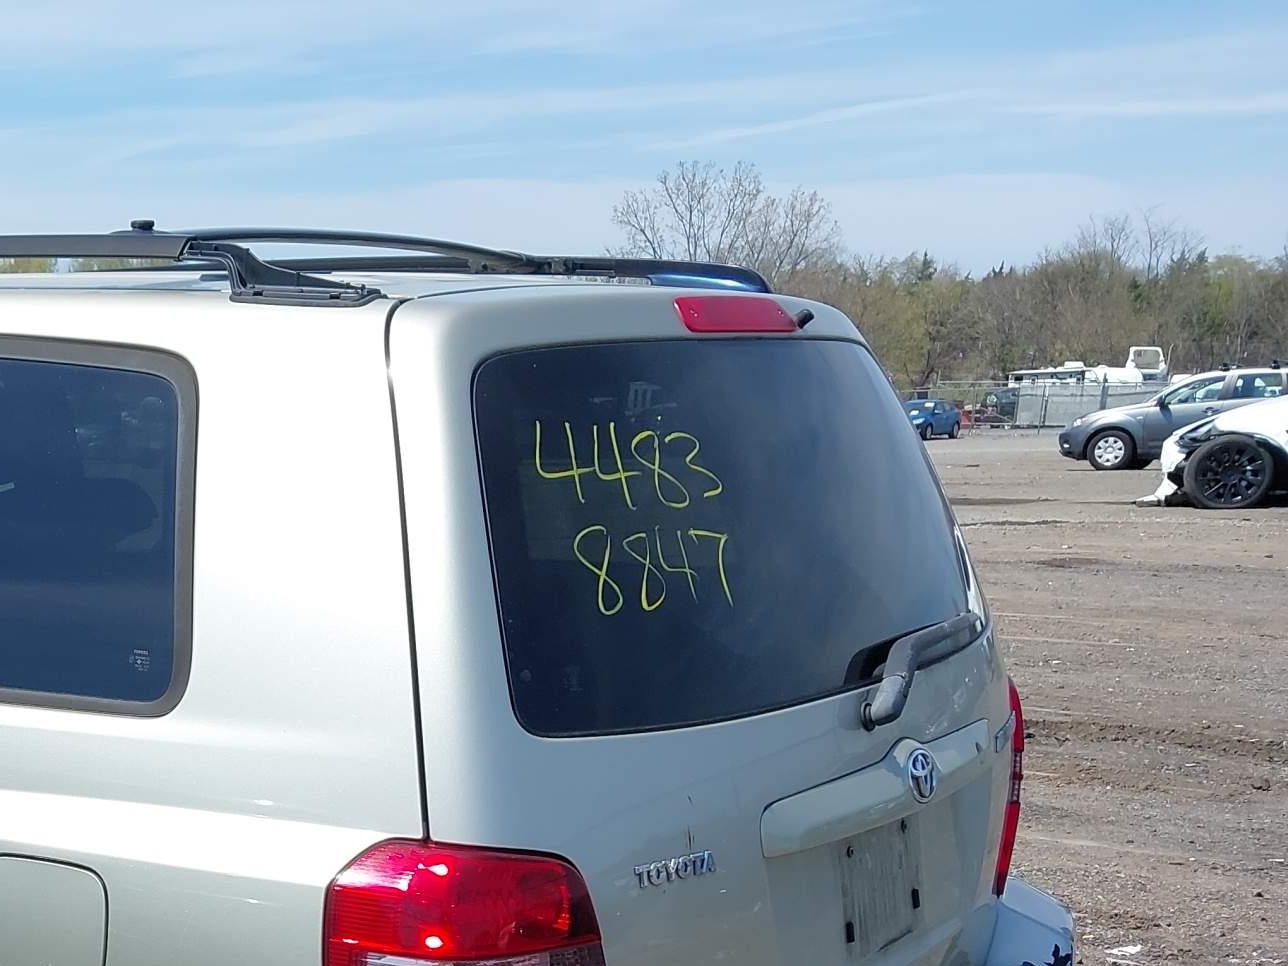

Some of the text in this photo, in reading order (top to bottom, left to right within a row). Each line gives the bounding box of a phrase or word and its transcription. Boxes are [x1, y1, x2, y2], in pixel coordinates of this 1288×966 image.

[535, 419, 723, 510] 4483
[573, 524, 734, 616] 8847
[633, 850, 717, 889] TOYOTA
